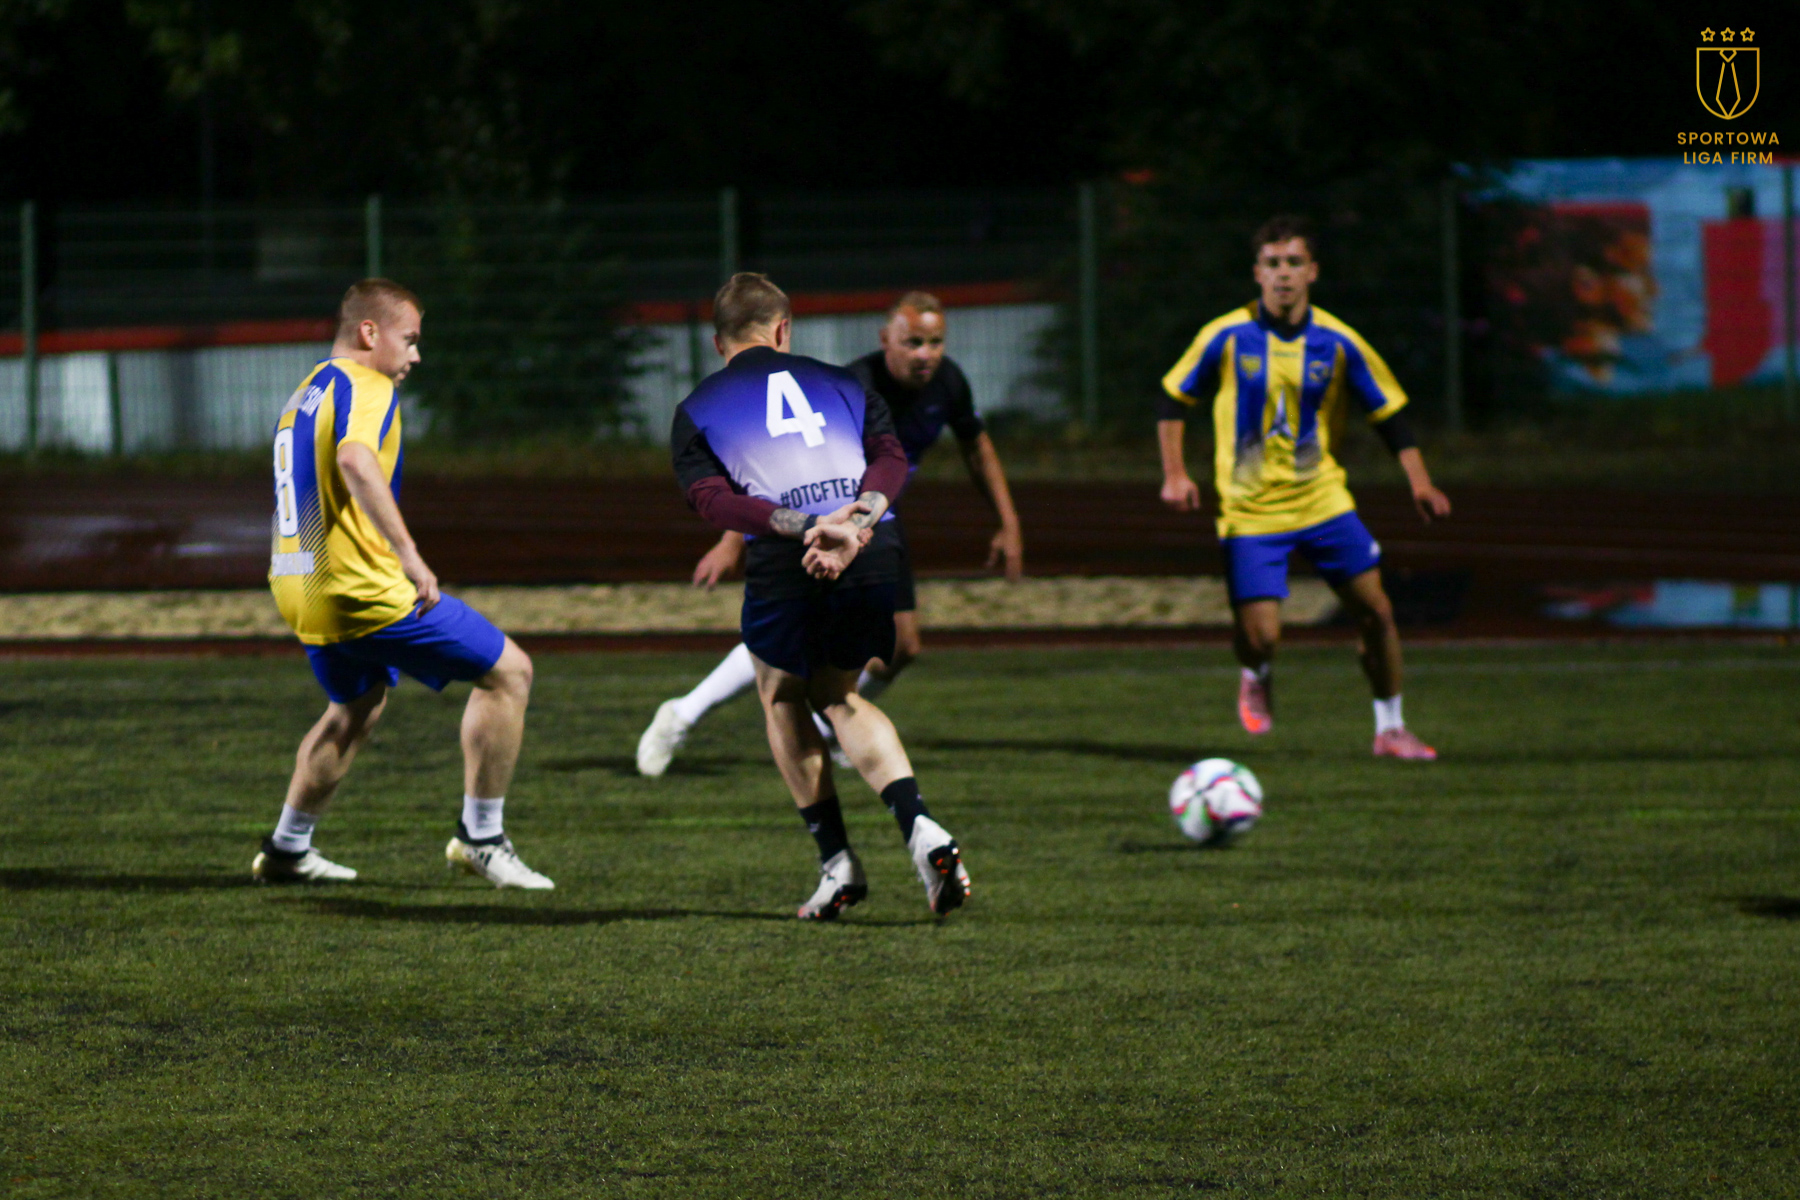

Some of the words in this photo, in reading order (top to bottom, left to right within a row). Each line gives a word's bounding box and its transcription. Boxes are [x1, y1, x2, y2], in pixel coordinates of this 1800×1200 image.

[766, 370, 827, 448] 4
[274, 426, 299, 538] 8
[780, 477, 862, 509] #OTCFTEA
